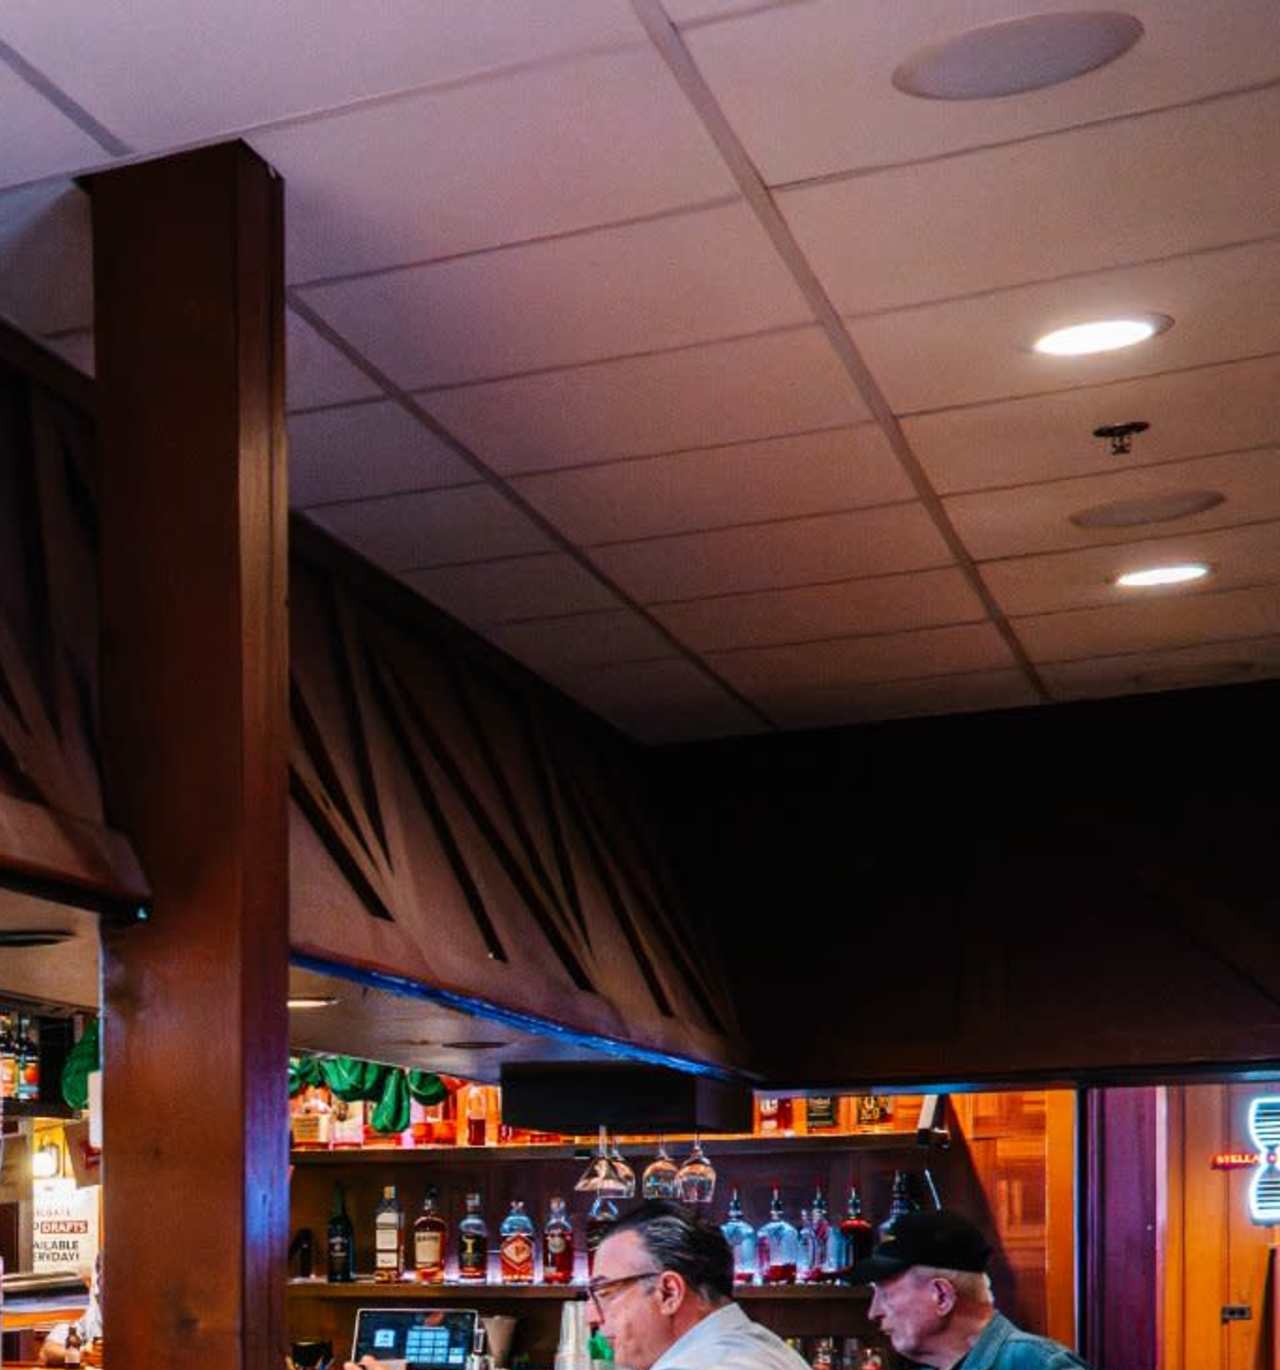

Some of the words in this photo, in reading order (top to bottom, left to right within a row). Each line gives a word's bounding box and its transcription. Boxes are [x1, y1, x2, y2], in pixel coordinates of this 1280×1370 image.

[1216, 1154, 1259, 1164] STELLA
[42, 1222, 87, 1233] DRAFTS
[33, 1240, 80, 1250] AILABLE
